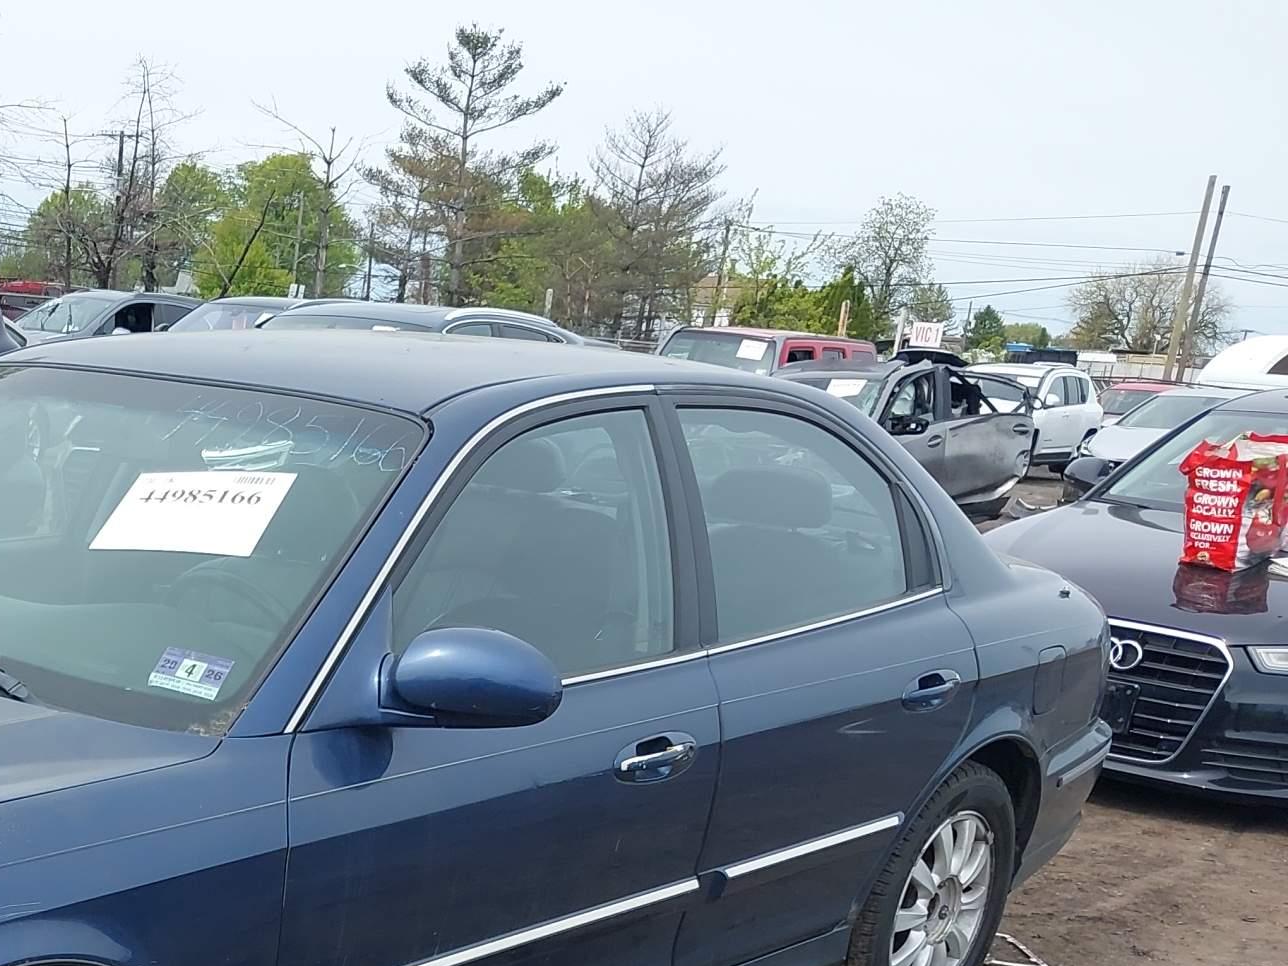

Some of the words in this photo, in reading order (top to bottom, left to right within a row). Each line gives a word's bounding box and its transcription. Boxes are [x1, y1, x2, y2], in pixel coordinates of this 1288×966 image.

[915, 326, 932, 343] VIC
[1195, 466, 1243, 479] GROWN
[1194, 478, 1241, 492] FRESH.
[140, 489, 262, 505] 44985166
[1193, 492, 1239, 508] GROWN
[1189, 519, 1234, 534] GROWN
[184, 663, 197, 678] 4
[205, 669, 224, 682] 26
